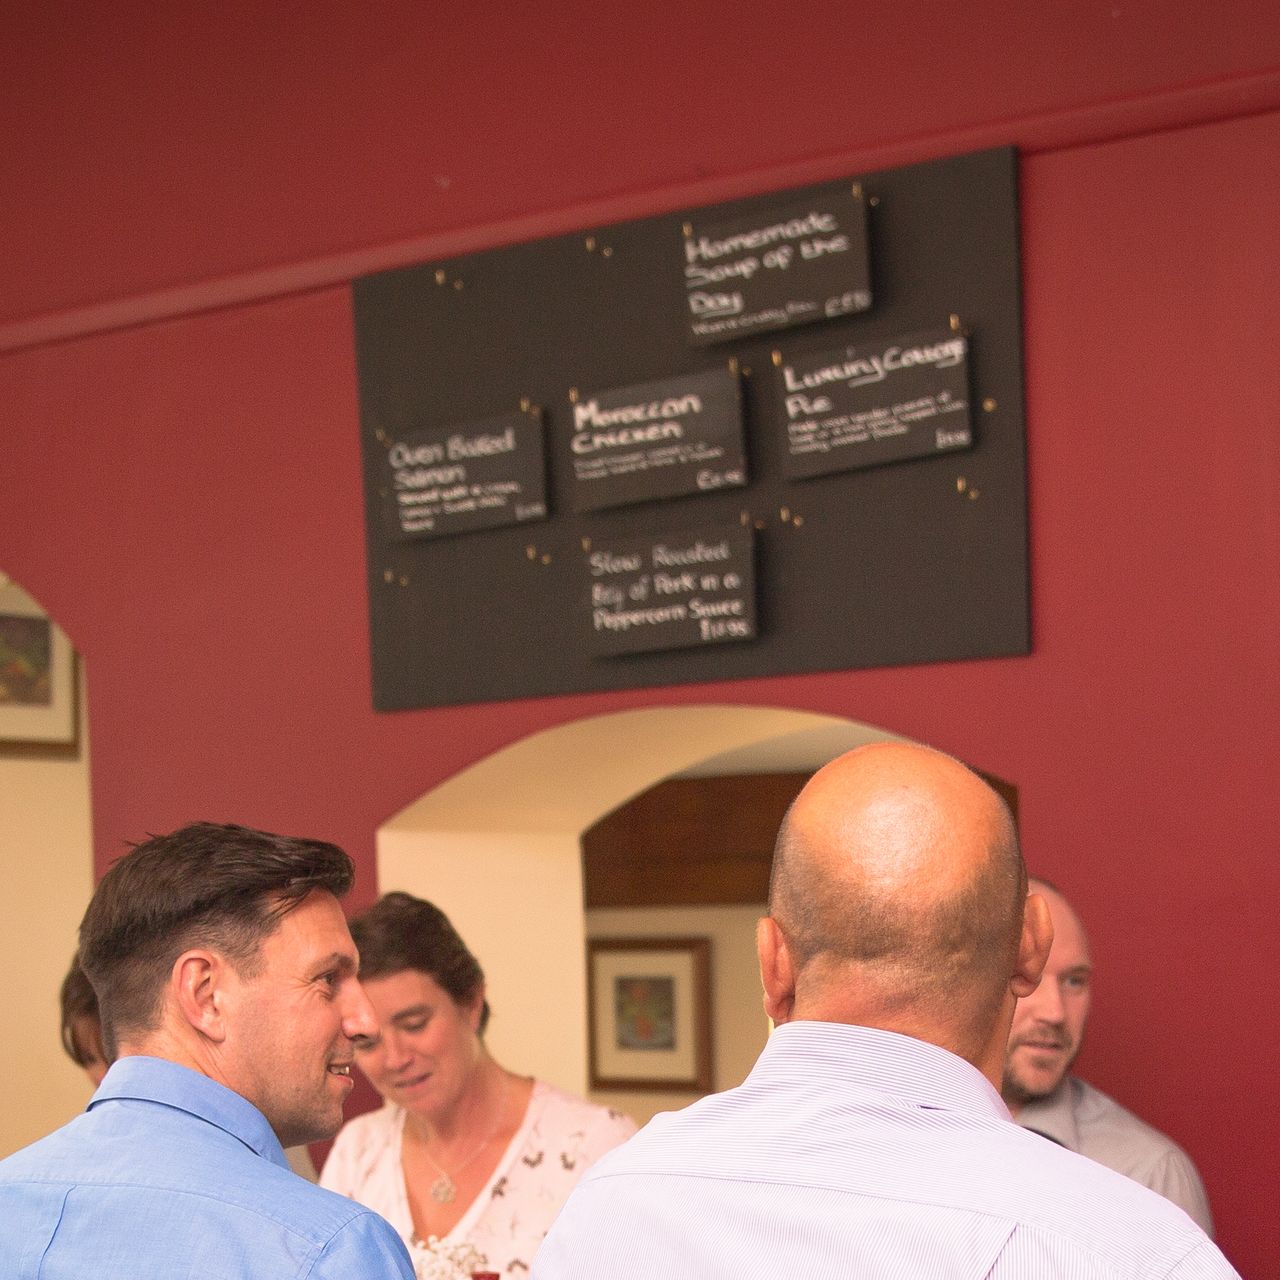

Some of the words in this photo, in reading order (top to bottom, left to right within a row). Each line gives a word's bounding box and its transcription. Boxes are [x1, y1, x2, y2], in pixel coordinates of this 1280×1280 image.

[685, 211, 838, 262] Homemade
[684, 255, 760, 288] Soup
[762, 244, 793, 270] of
[800, 234, 849, 260] the
[688, 291, 744, 319] Day
[574, 394, 702, 431] Moroccan
[785, 393, 832, 421] Pie
[389, 442, 445, 470] Oven
[446, 426, 516, 461] Baked
[571, 420, 683, 454] Chicken
[394, 465, 466, 490] Salmon
[590, 552, 642, 577] Slow
[652, 541, 731, 569] Roasted
[653, 571, 696, 595] Pork
[593, 606, 688, 631] Peppercorn
[688, 597, 745, 618] Sauce
